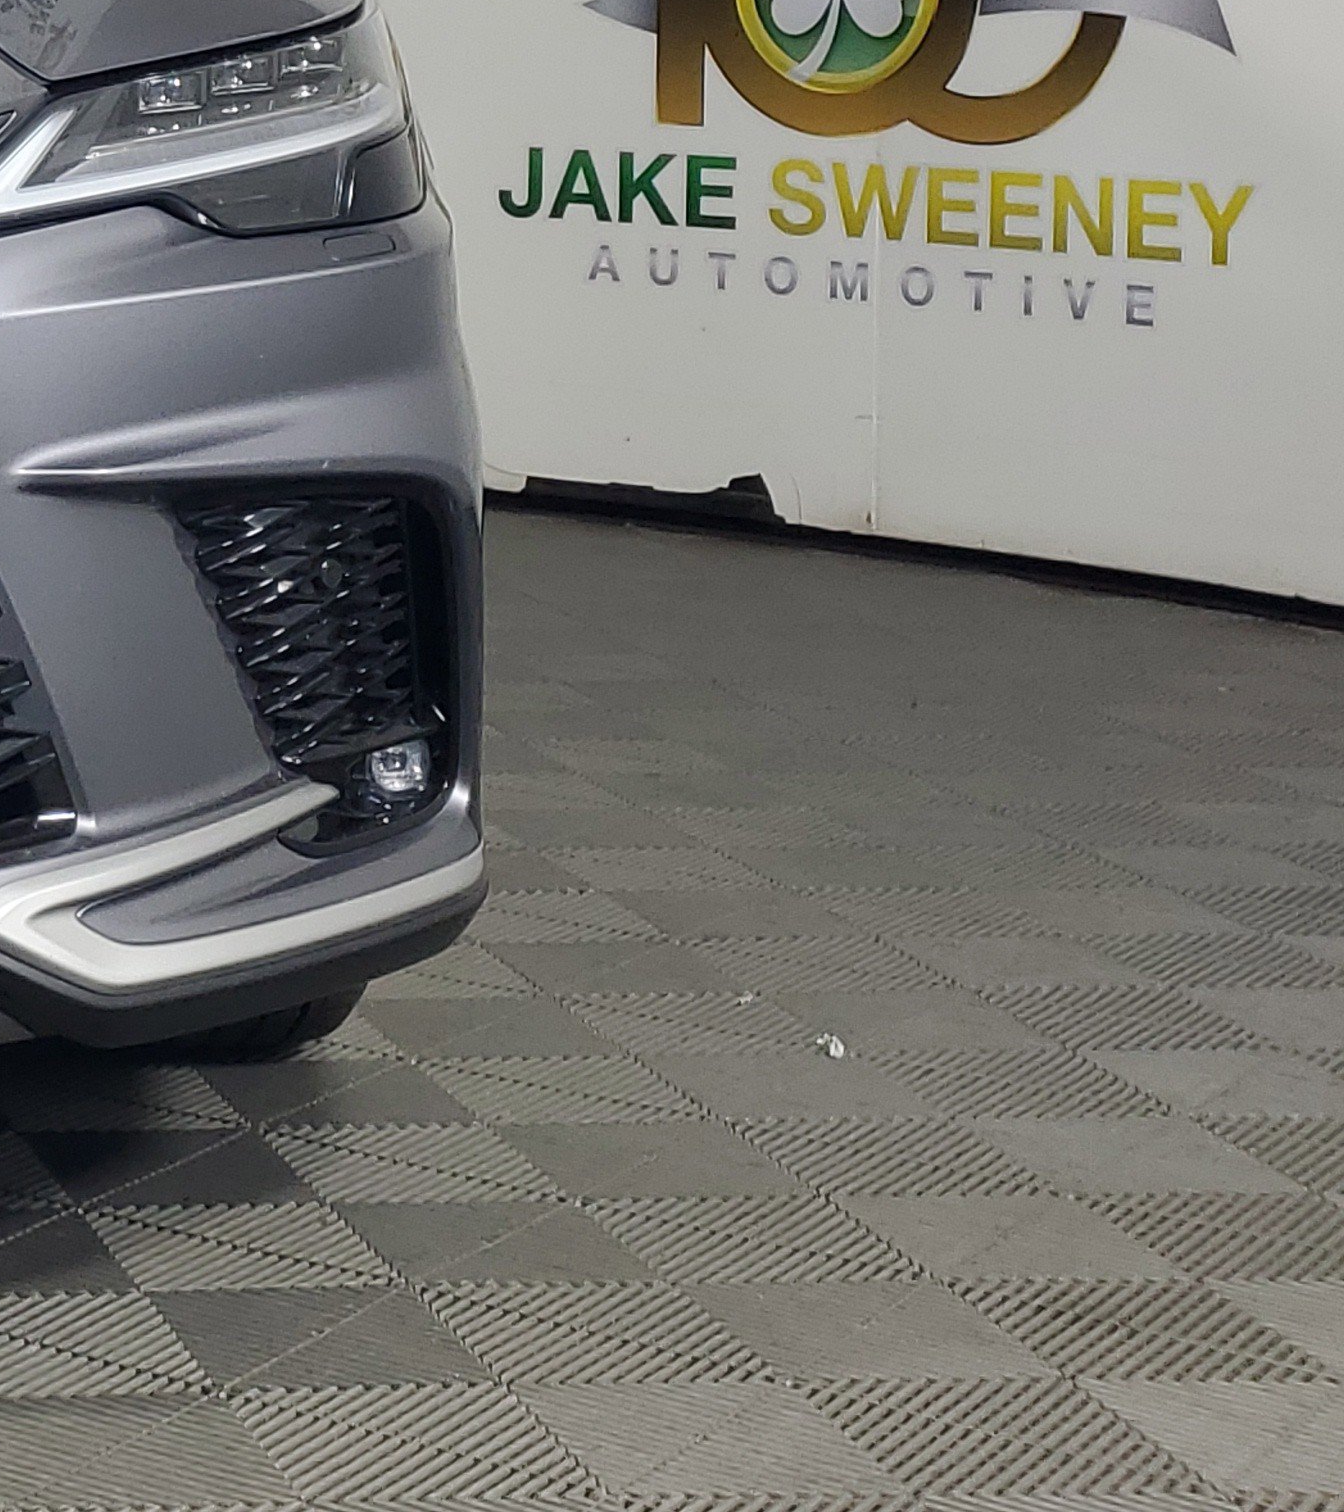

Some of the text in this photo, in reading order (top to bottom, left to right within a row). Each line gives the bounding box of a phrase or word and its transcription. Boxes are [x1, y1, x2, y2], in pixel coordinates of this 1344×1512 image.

[498, 146, 1254, 267] JAKE SWEENEY
[588, 244, 1155, 328] AUTOMOTIVE
